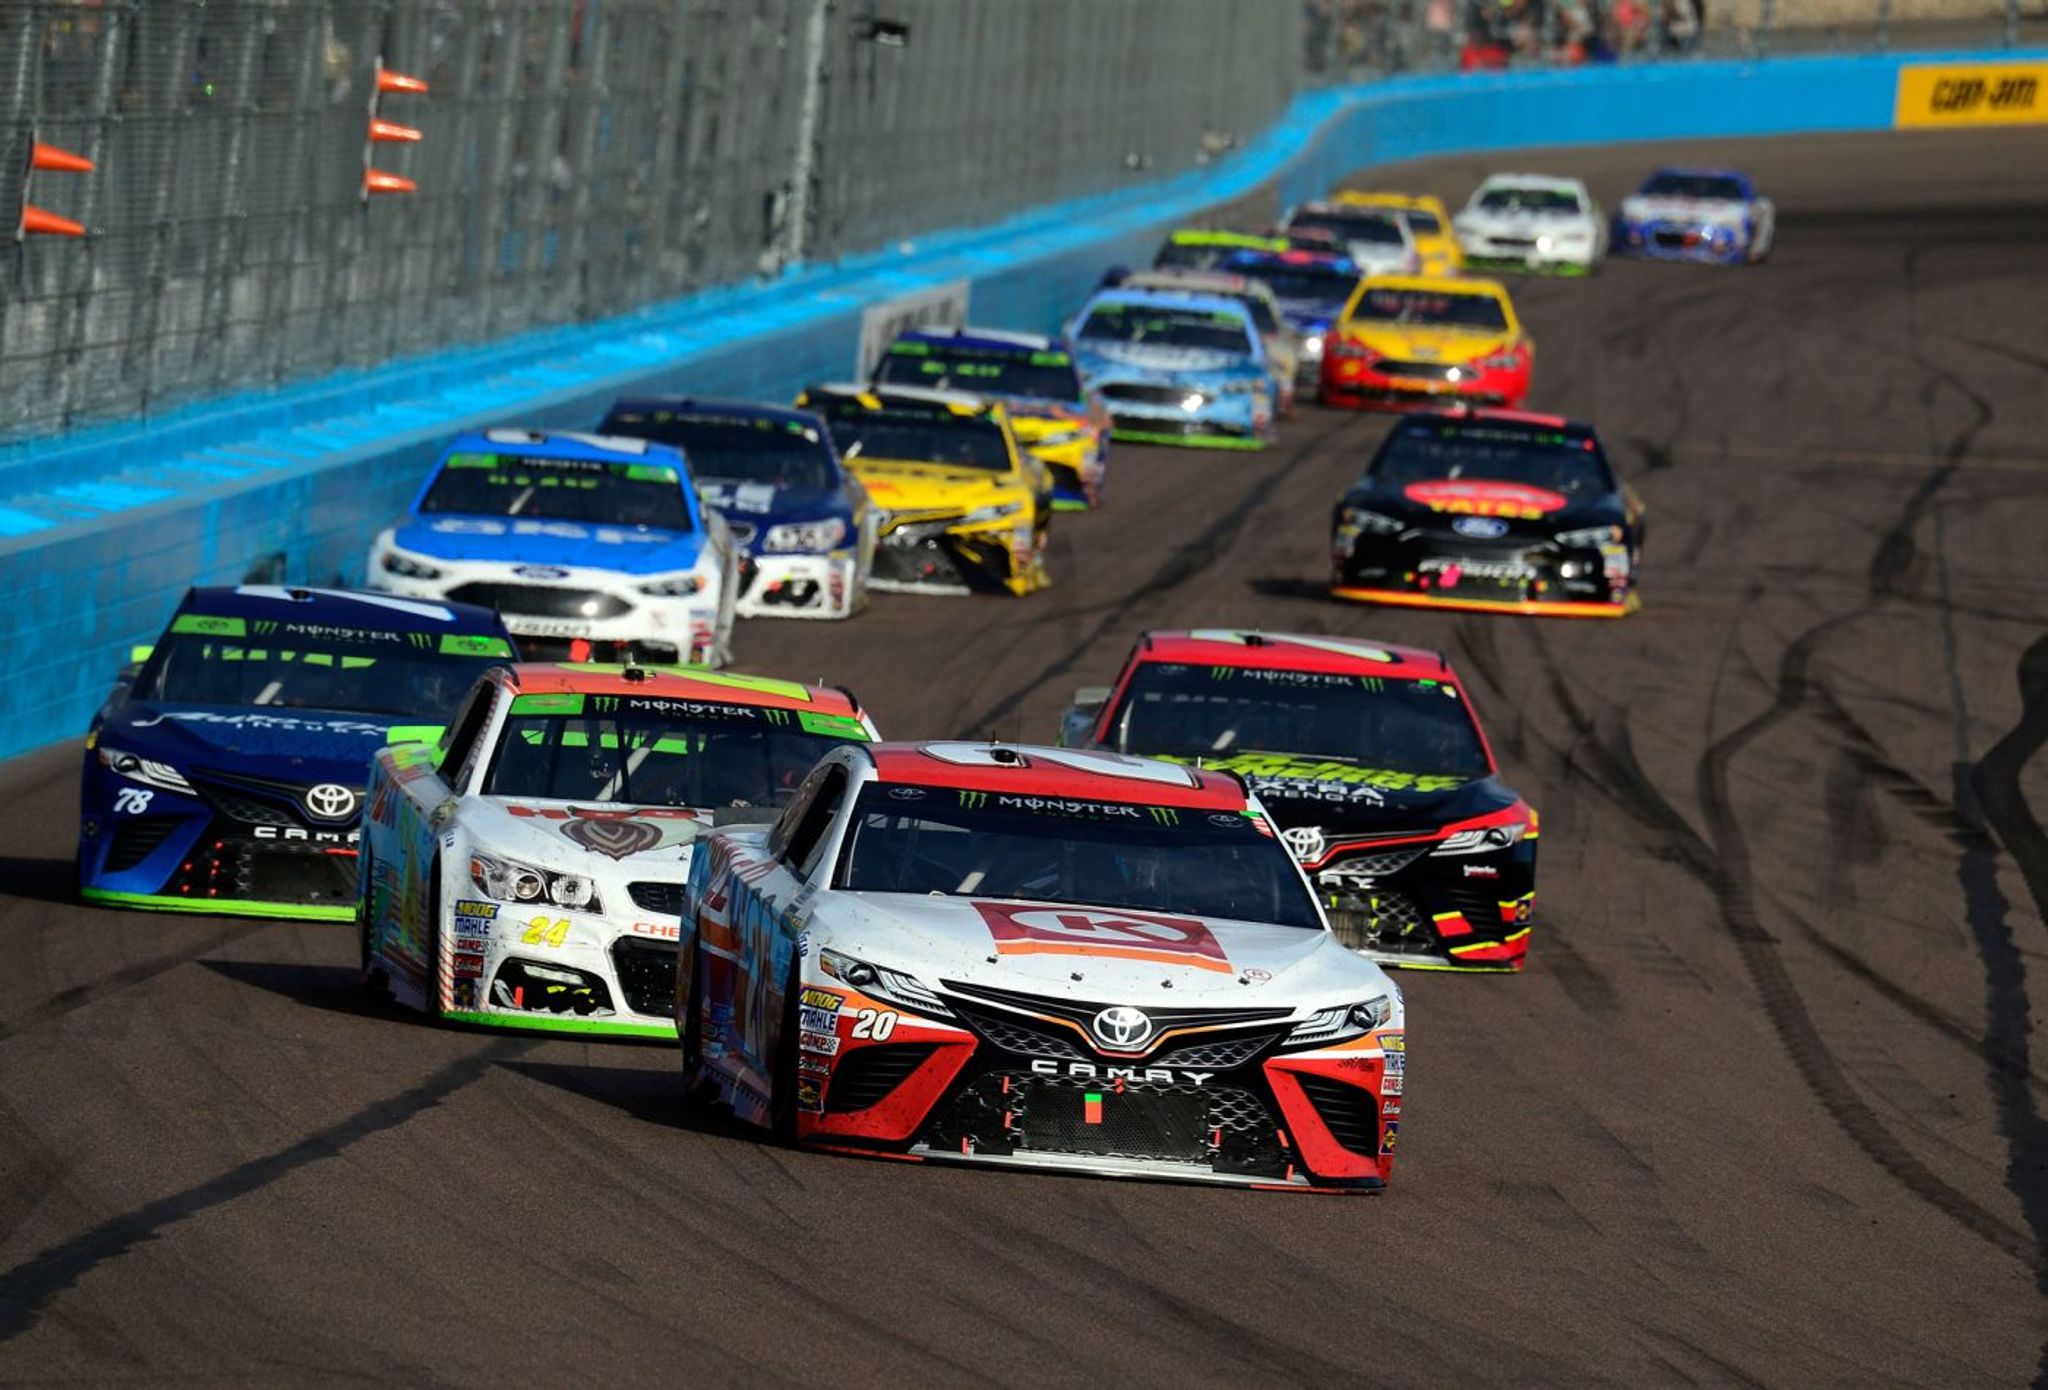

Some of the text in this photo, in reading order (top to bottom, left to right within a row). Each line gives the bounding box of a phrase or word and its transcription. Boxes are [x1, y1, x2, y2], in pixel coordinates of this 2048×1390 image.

[286, 623, 401, 642] MONSTER
[630, 699, 757, 718] MONSTER
[112, 786, 155, 815] 78
[999, 795, 1141, 818] MONSTER
[456, 902, 496, 916] MOOG
[454, 917, 491, 935] MAHLE
[521, 915, 571, 948] 24
[801, 989, 839, 1009] MOOG
[801, 1009, 837, 1031] MAHLE
[851, 1008, 898, 1042] 20
[1031, 1058, 1215, 1086] CAMRY
